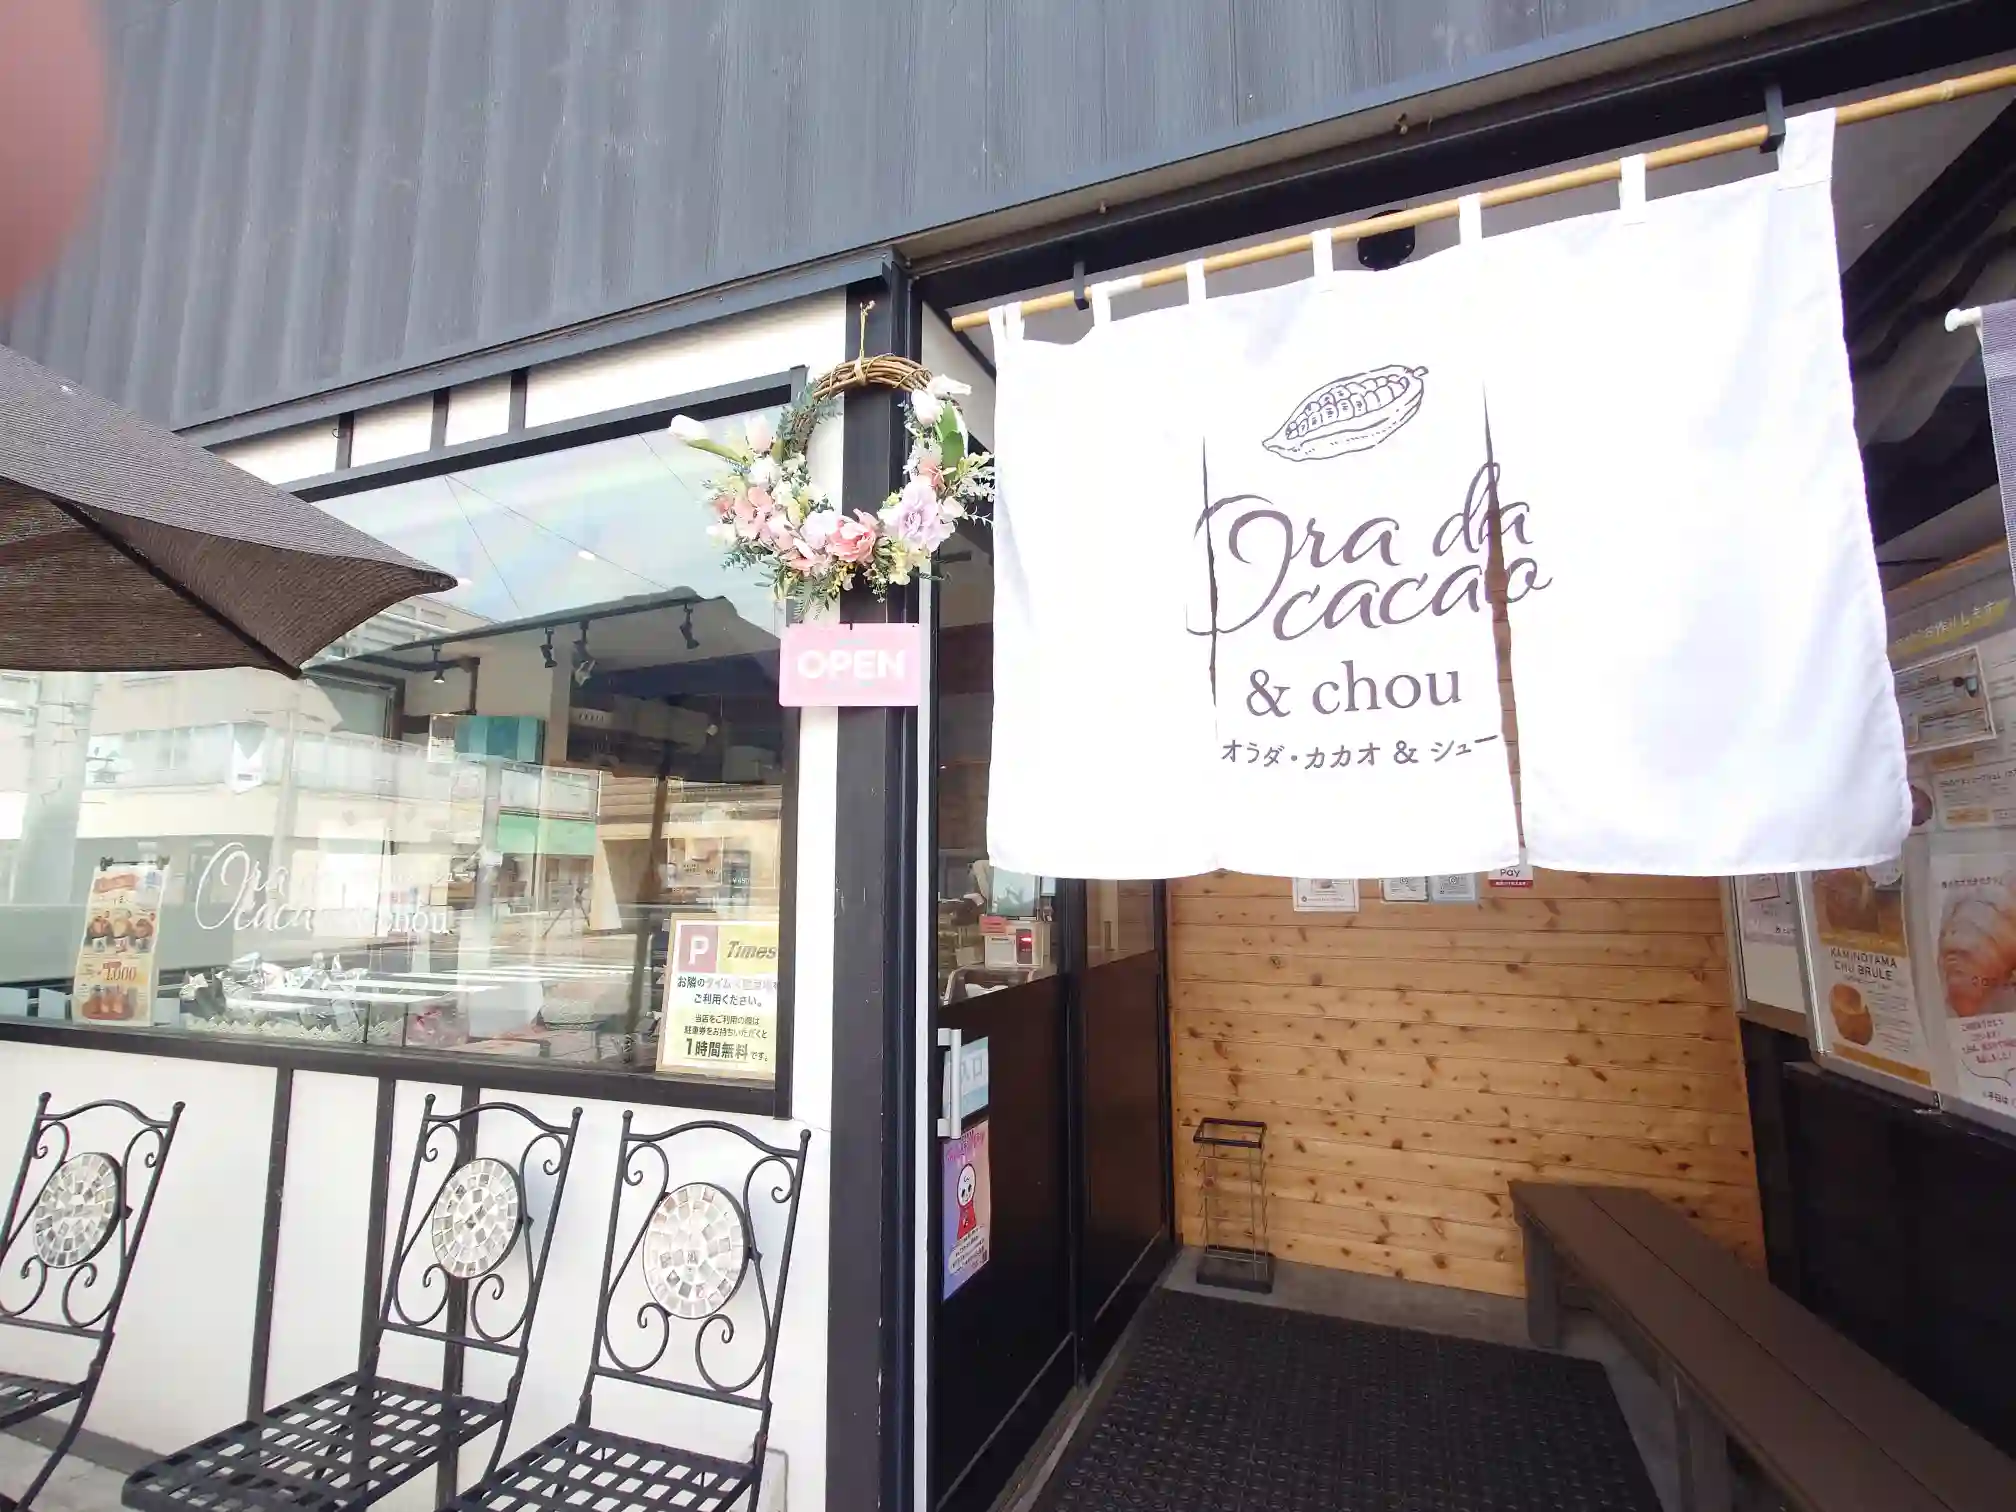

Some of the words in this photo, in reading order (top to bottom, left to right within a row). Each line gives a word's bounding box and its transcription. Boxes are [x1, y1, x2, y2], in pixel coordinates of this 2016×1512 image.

[1186, 494, 1401, 636] Ora
[1433, 462, 1533, 556] da
[1273, 557, 1553, 640] cacao
[797, 650, 907, 679] OPEN
[1246, 669, 1291, 718] &
[1312, 660, 1462, 715] chou
[1394, 740, 1419, 764] &
[1430, 735, 1499, 762] シュー
[688, 935, 710, 966] P
[727, 941, 777, 960] Times
[694, 993, 762, 1008] ご利用ください。
